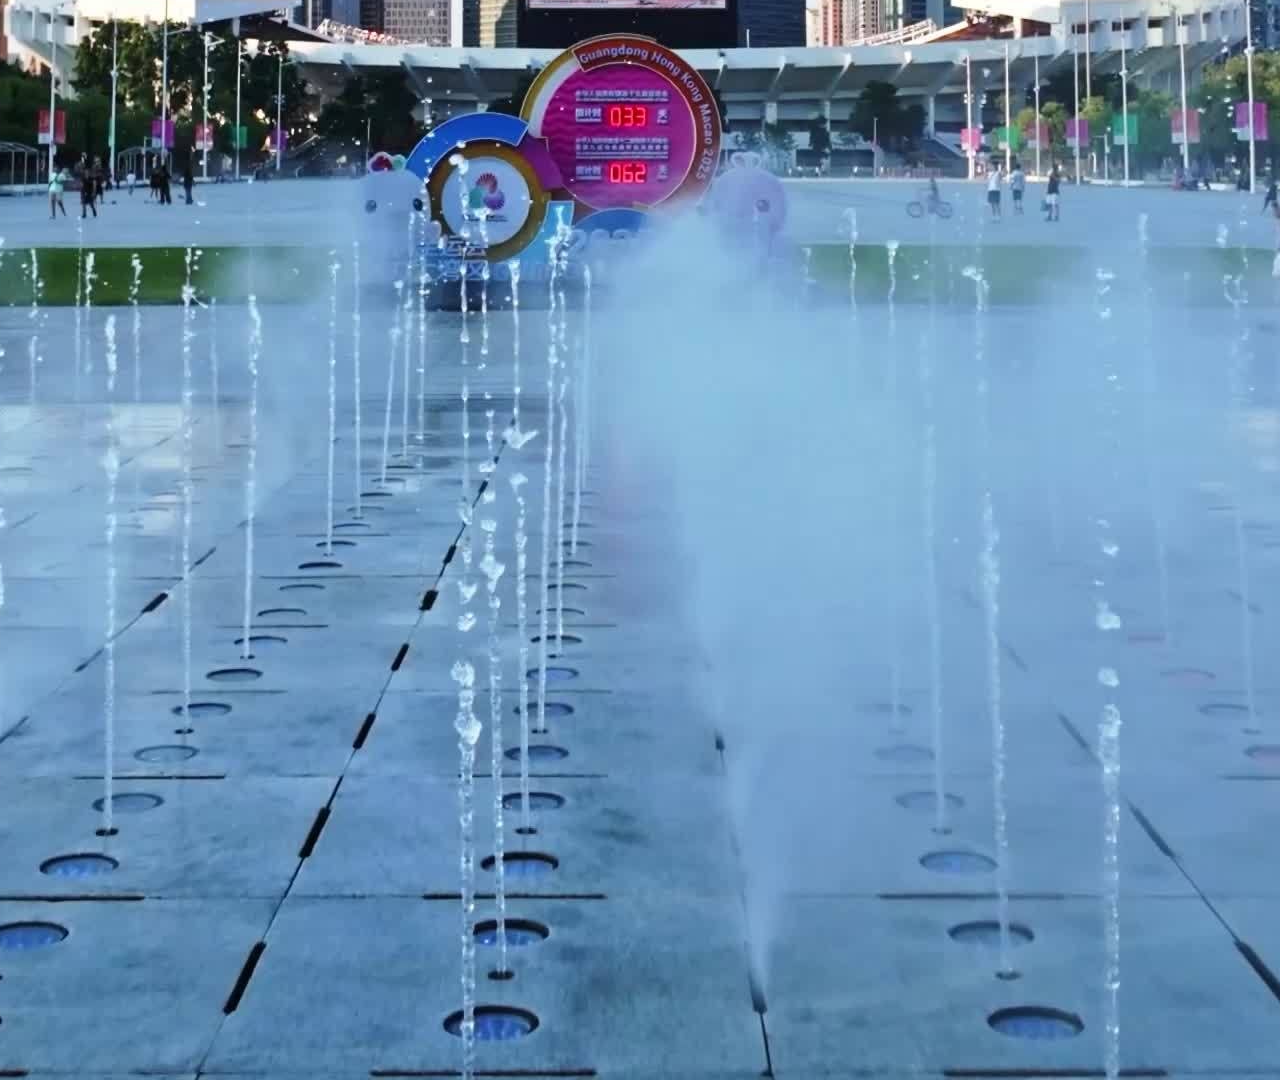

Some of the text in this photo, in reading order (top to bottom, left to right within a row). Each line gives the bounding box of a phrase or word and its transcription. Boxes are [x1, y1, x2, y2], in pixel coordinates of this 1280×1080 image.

[579, 44, 714, 181] Guangdong Hong Kong Macao 2025
[610, 107, 647, 127] 033
[610, 163, 647, 183] 062
